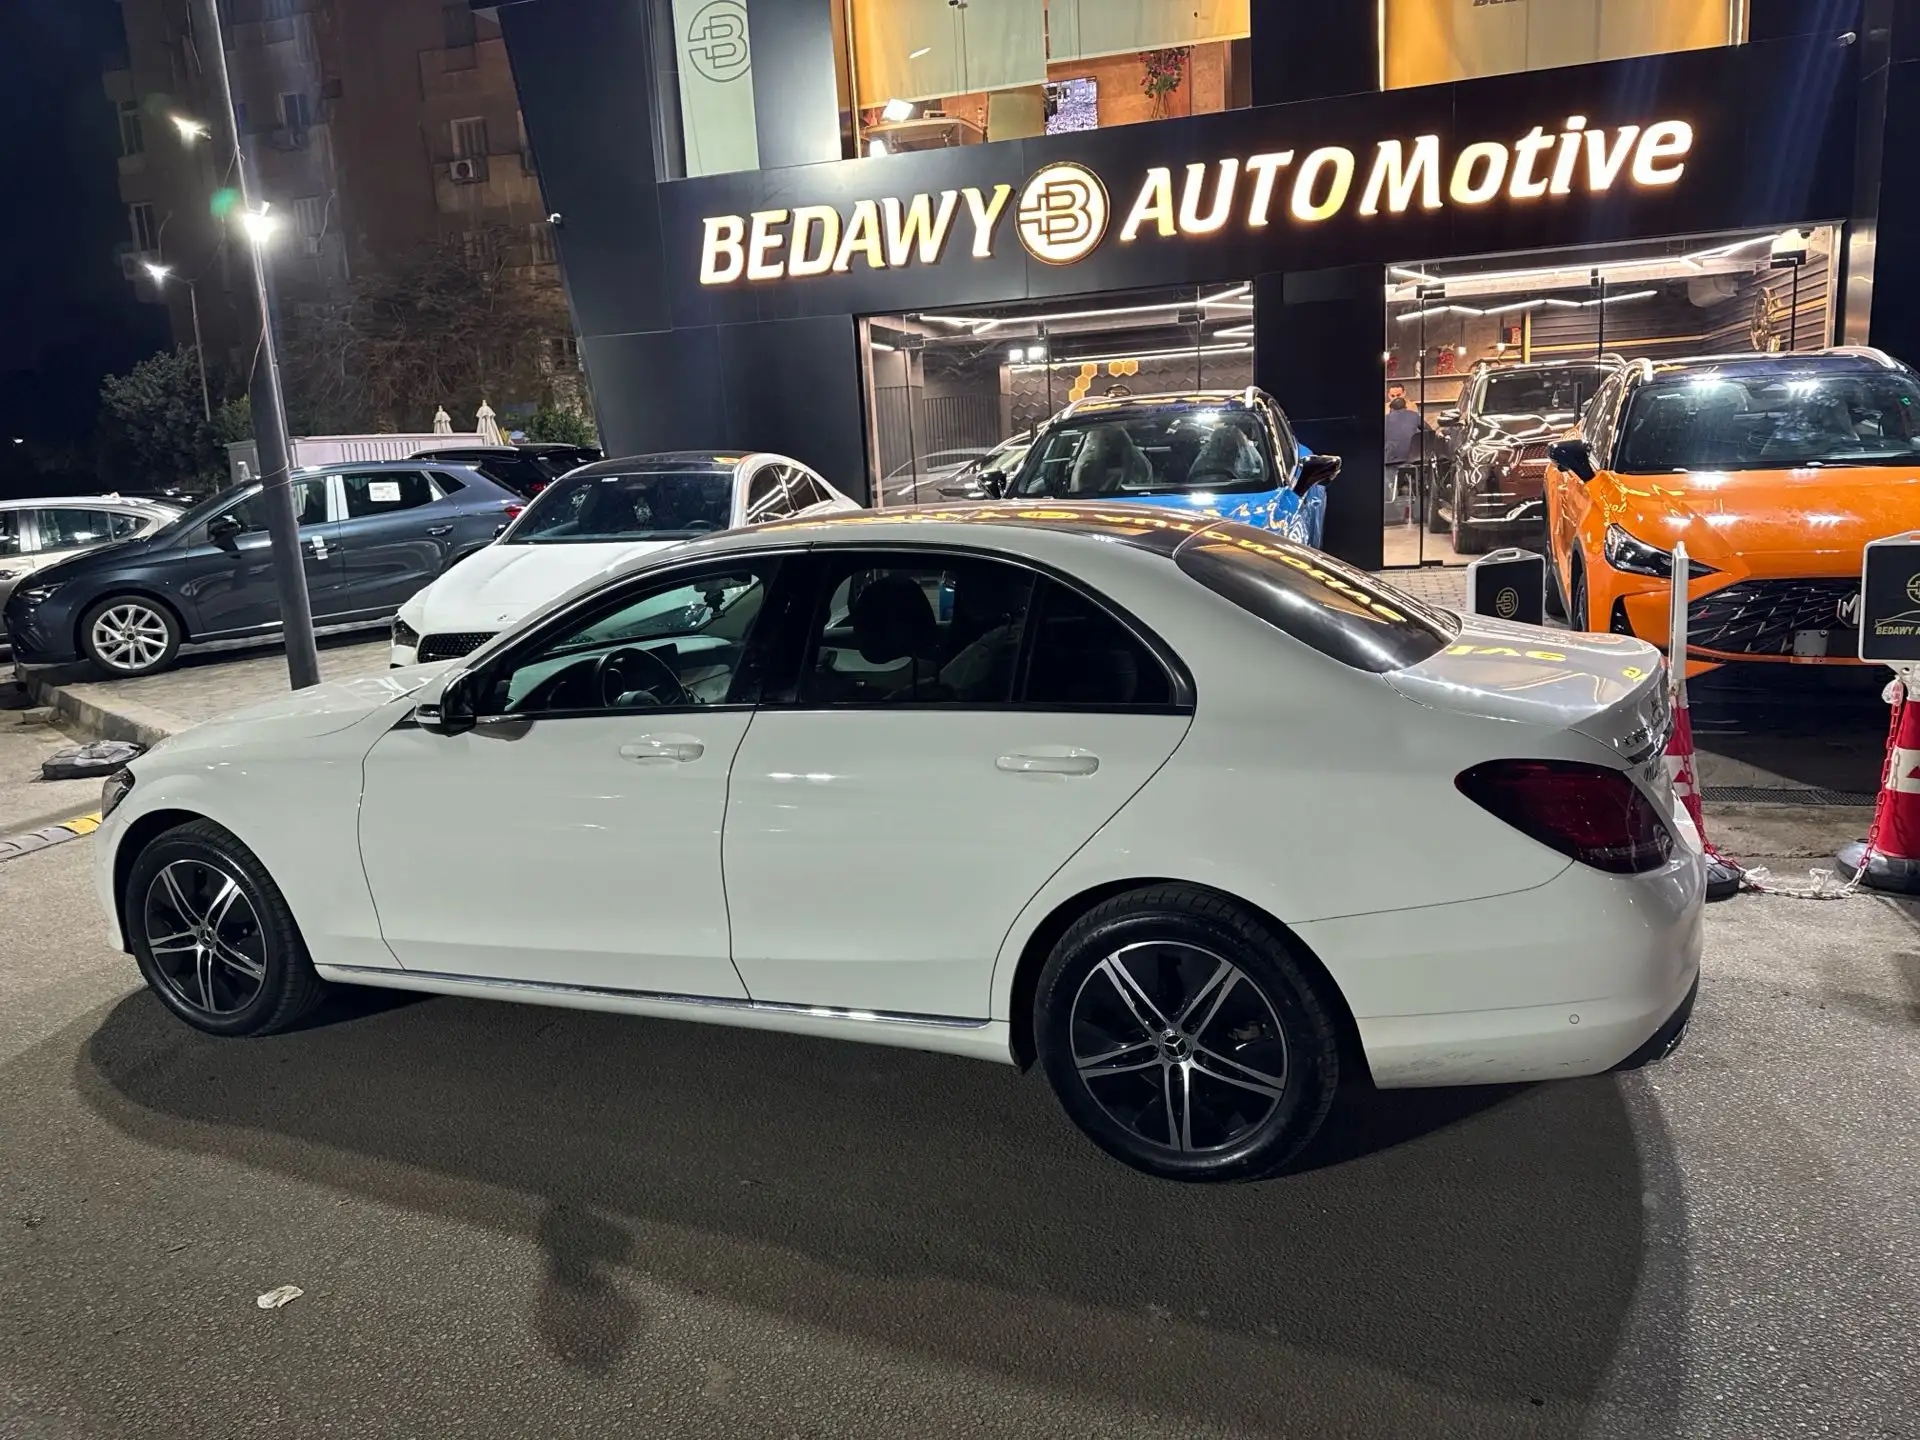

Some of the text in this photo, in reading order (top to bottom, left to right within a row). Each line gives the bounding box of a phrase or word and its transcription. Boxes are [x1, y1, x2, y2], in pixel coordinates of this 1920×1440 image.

[699, 184, 1011, 285] BEDAWY
[1841, 593, 1862, 625] M
[1875, 626, 1914, 636] BEDAWY
